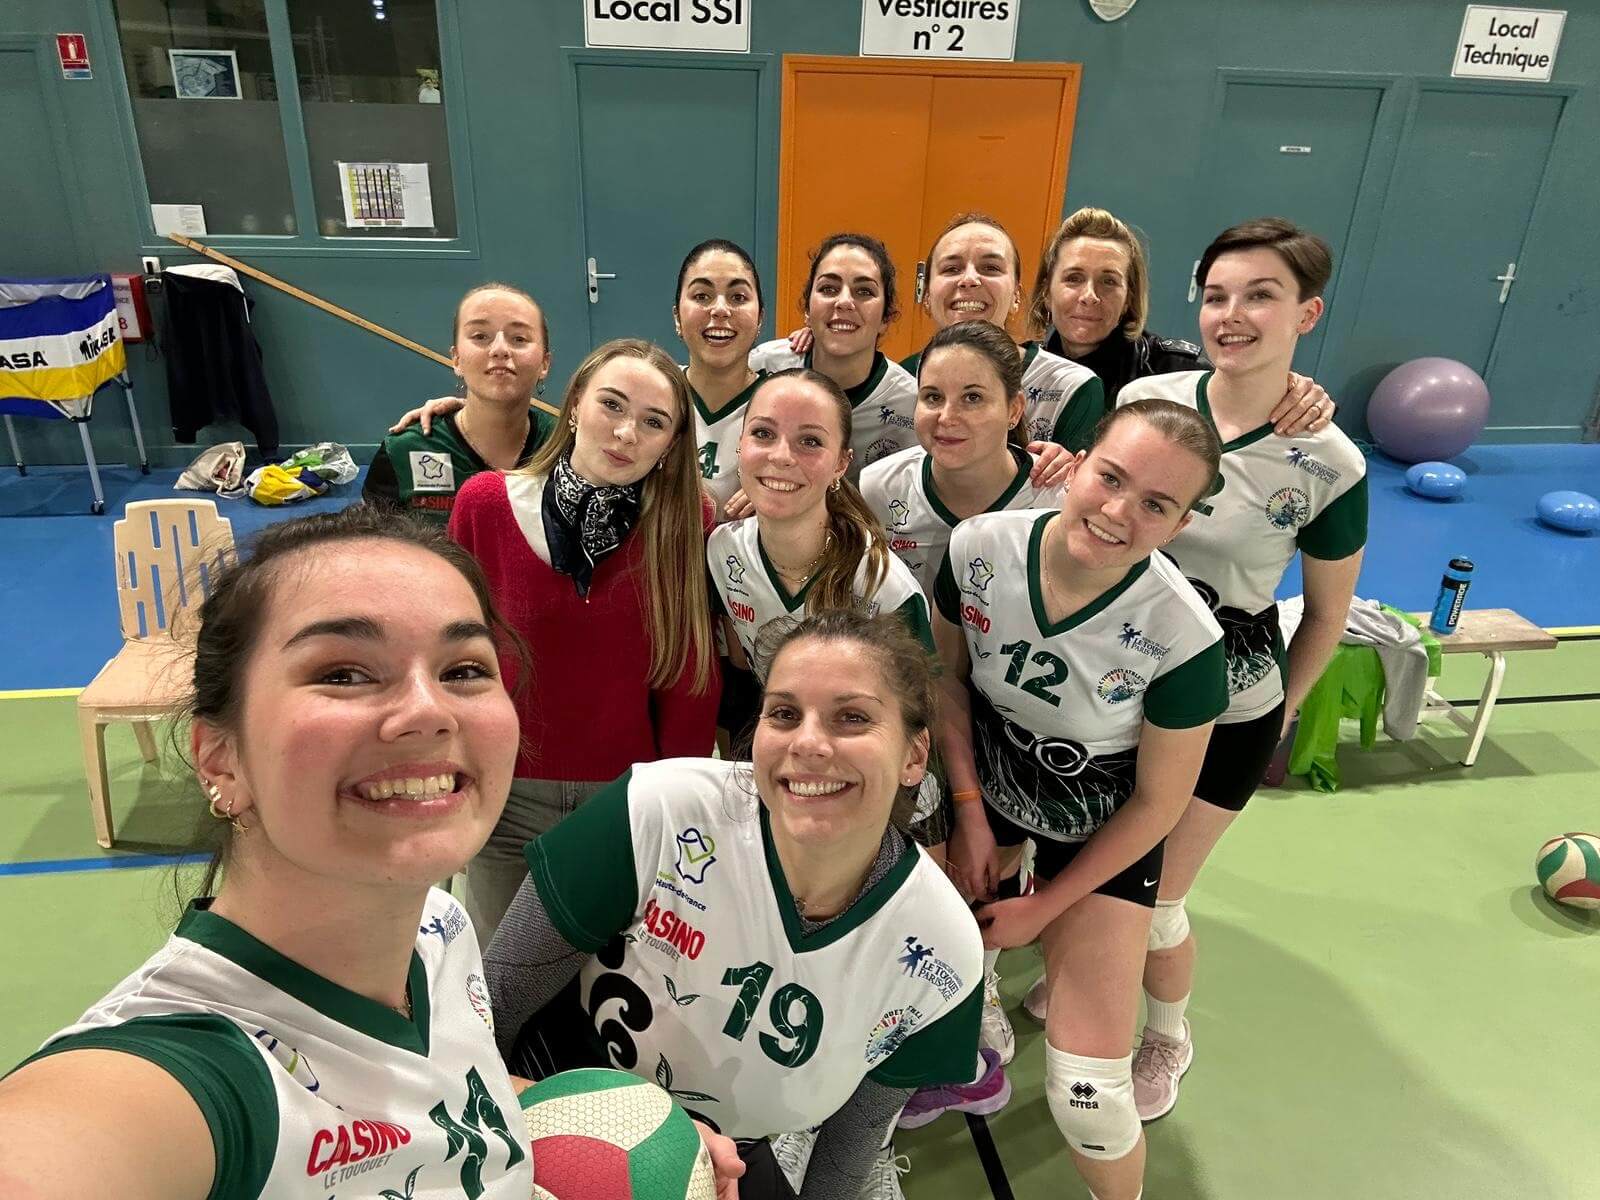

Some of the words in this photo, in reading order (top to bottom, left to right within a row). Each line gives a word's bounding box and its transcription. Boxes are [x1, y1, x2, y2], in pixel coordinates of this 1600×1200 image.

[594, 0, 681, 22] Local
[691, 0, 742, 25] SSI
[878, 0, 1009, 20] Vestiaires
[946, 24, 965, 52] 2
[1488, 16, 1539, 39] Local
[1463, 43, 1550, 73] Technique
[1447, 582, 1468, 626] POWERADE
[1000, 640, 1069, 708] 12
[720, 960, 824, 1069] 19
[306, 1118, 412, 1177] CASINO
[324, 1170, 339, 1190] LE
[340, 1153, 394, 1183] TOUQUET
